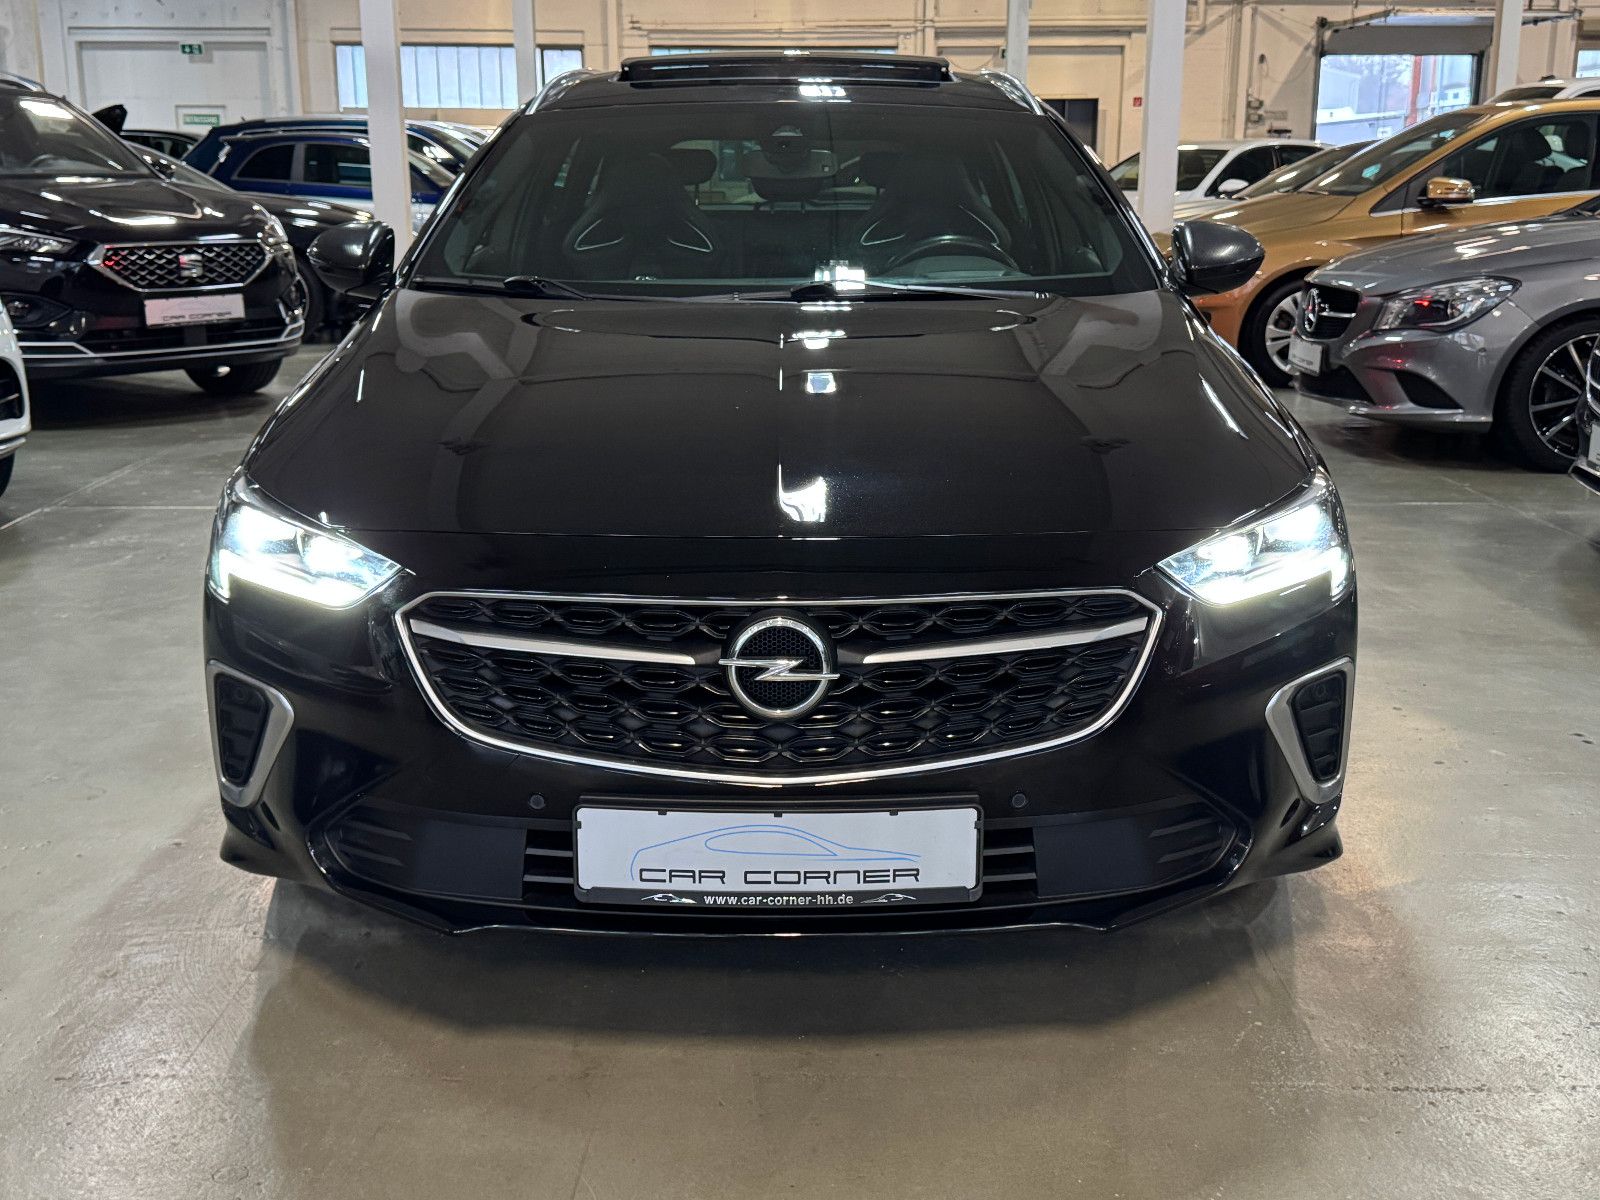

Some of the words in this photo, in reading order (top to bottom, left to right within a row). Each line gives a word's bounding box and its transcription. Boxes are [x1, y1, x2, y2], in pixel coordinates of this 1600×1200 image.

[639, 867, 726, 885] CAR
[743, 867, 920, 885] CORNER
[703, 893, 854, 906] www.car-corner-hh.de
